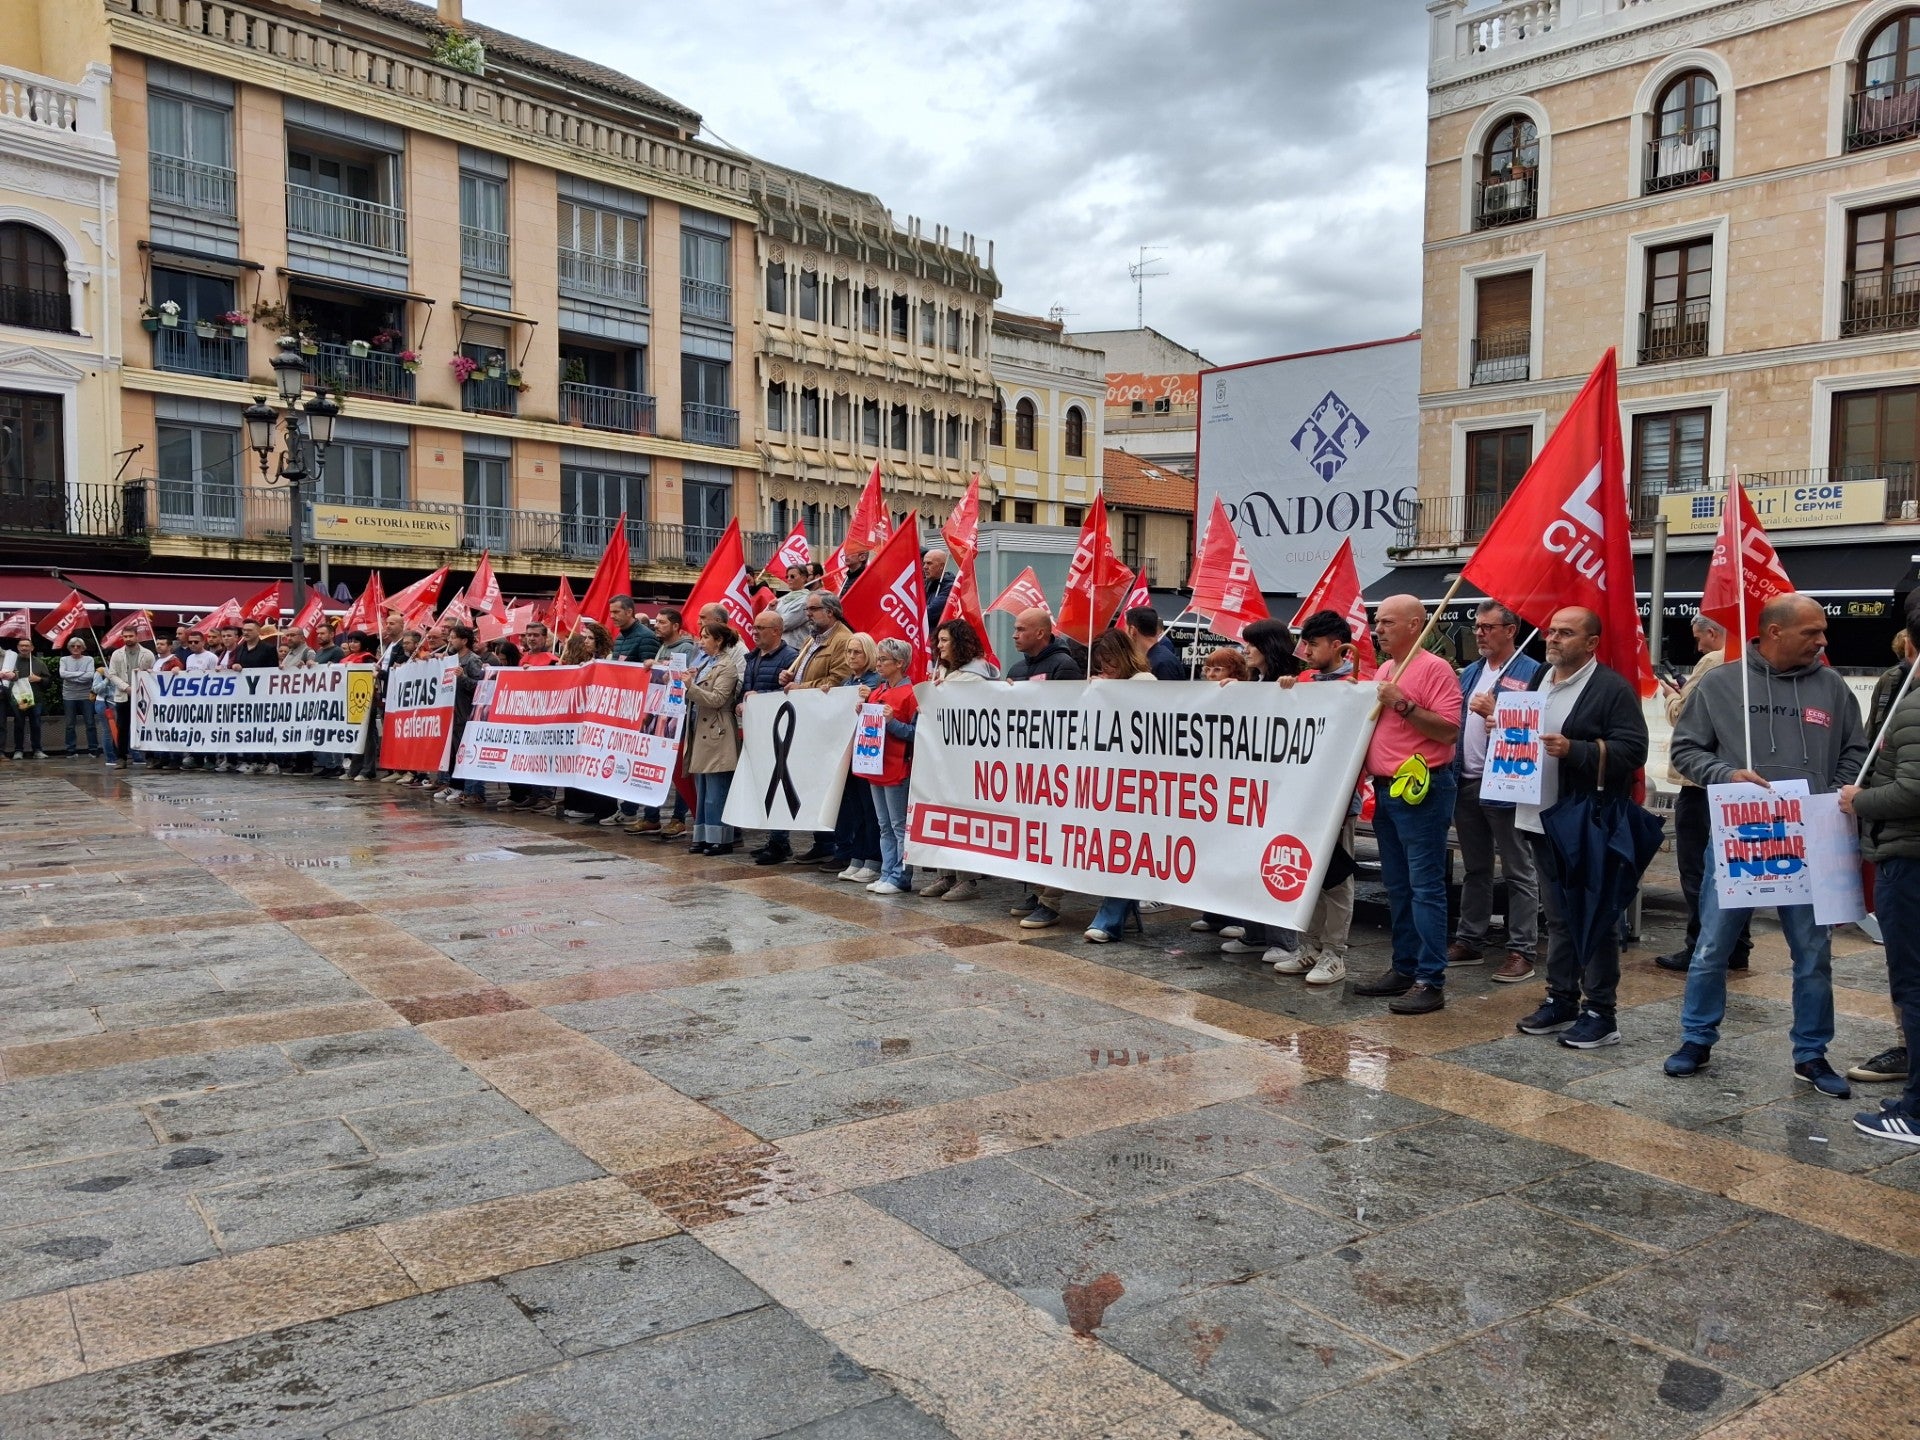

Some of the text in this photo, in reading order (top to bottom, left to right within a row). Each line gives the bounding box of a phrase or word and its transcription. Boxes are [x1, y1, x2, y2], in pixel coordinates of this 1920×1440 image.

[1794, 485, 1843, 501] CEOE
[1794, 500, 1843, 512] CEPYME
[355, 515, 450, 531] GESTORÍA HERVÁS
[1690, 521, 1721, 531] federac
[1795, 512, 1824, 523] ciudad
[1825, 511, 1842, 521] real
[1679, 603, 1700, 616] Vin
[157, 671, 342, 697] Vestas Y FREMAP
[153, 700, 345, 723] PROVOCAN ENFERMEDAD LABORAL
[1498, 708, 1540, 730] TRABAJAR
[1741, 704, 1787, 717] OMMY
[403, 710, 441, 738] enferma
[1006, 709, 1078, 751] FRENTE
[1080, 714, 1089, 751] A
[1093, 709, 1124, 752] LA
[136, 726, 152, 742] in
[155, 726, 206, 746] trabajo,
[210, 726, 230, 742] sin
[235, 725, 277, 745] salud,
[282, 725, 300, 742] sin
[607, 731, 651, 757] CONTROLES
[857, 744, 880, 757] NO
[1492, 756, 1536, 776] NO
[974, 760, 1269, 828] NO MAS MUERTES EN
[1721, 798, 1802, 827] TRABAJAR
[921, 810, 1013, 852] CCOO
[1026, 820, 1196, 884] EL TRABAJO
[1269, 845, 1303, 867] UGT
[1724, 834, 1805, 864] ENFERMAR
[1728, 853, 1803, 878] NO
